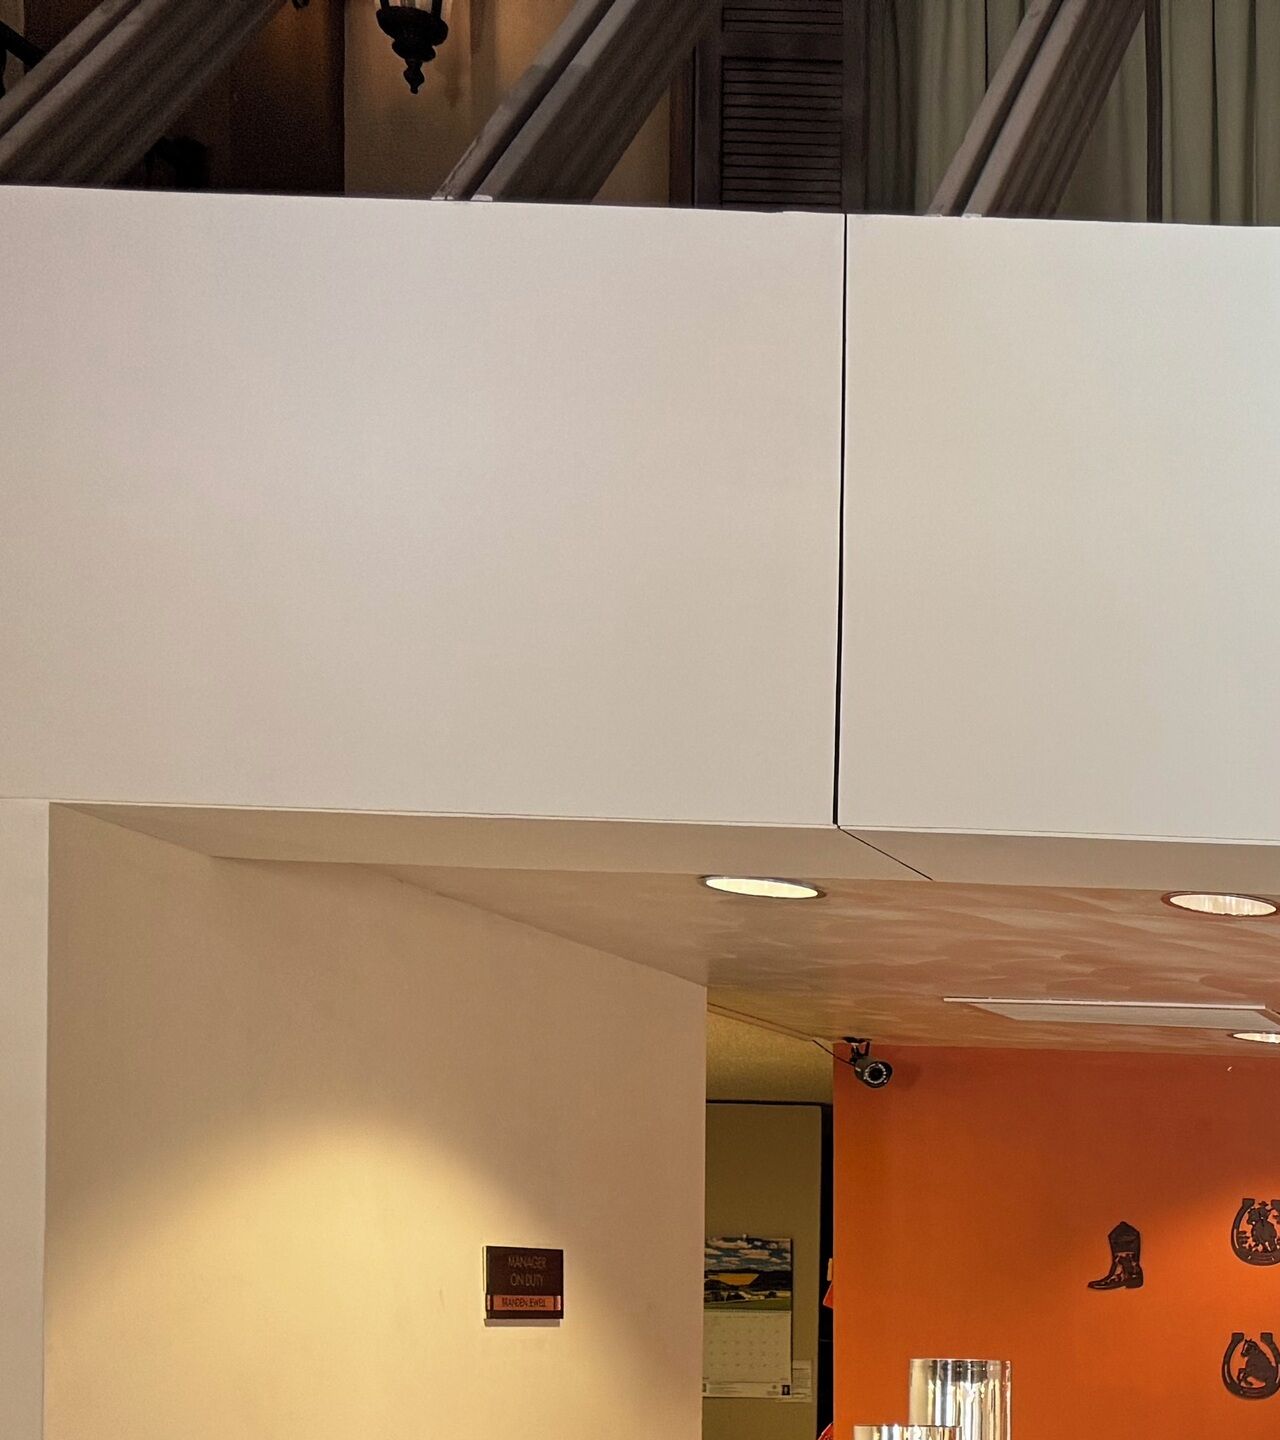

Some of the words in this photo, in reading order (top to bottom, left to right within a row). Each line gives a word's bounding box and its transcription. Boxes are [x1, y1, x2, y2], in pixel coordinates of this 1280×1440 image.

[508, 1256, 546, 1268] MANAGER
[511, 1273, 524, 1286] ON
[525, 1274, 544, 1287] DUTY
